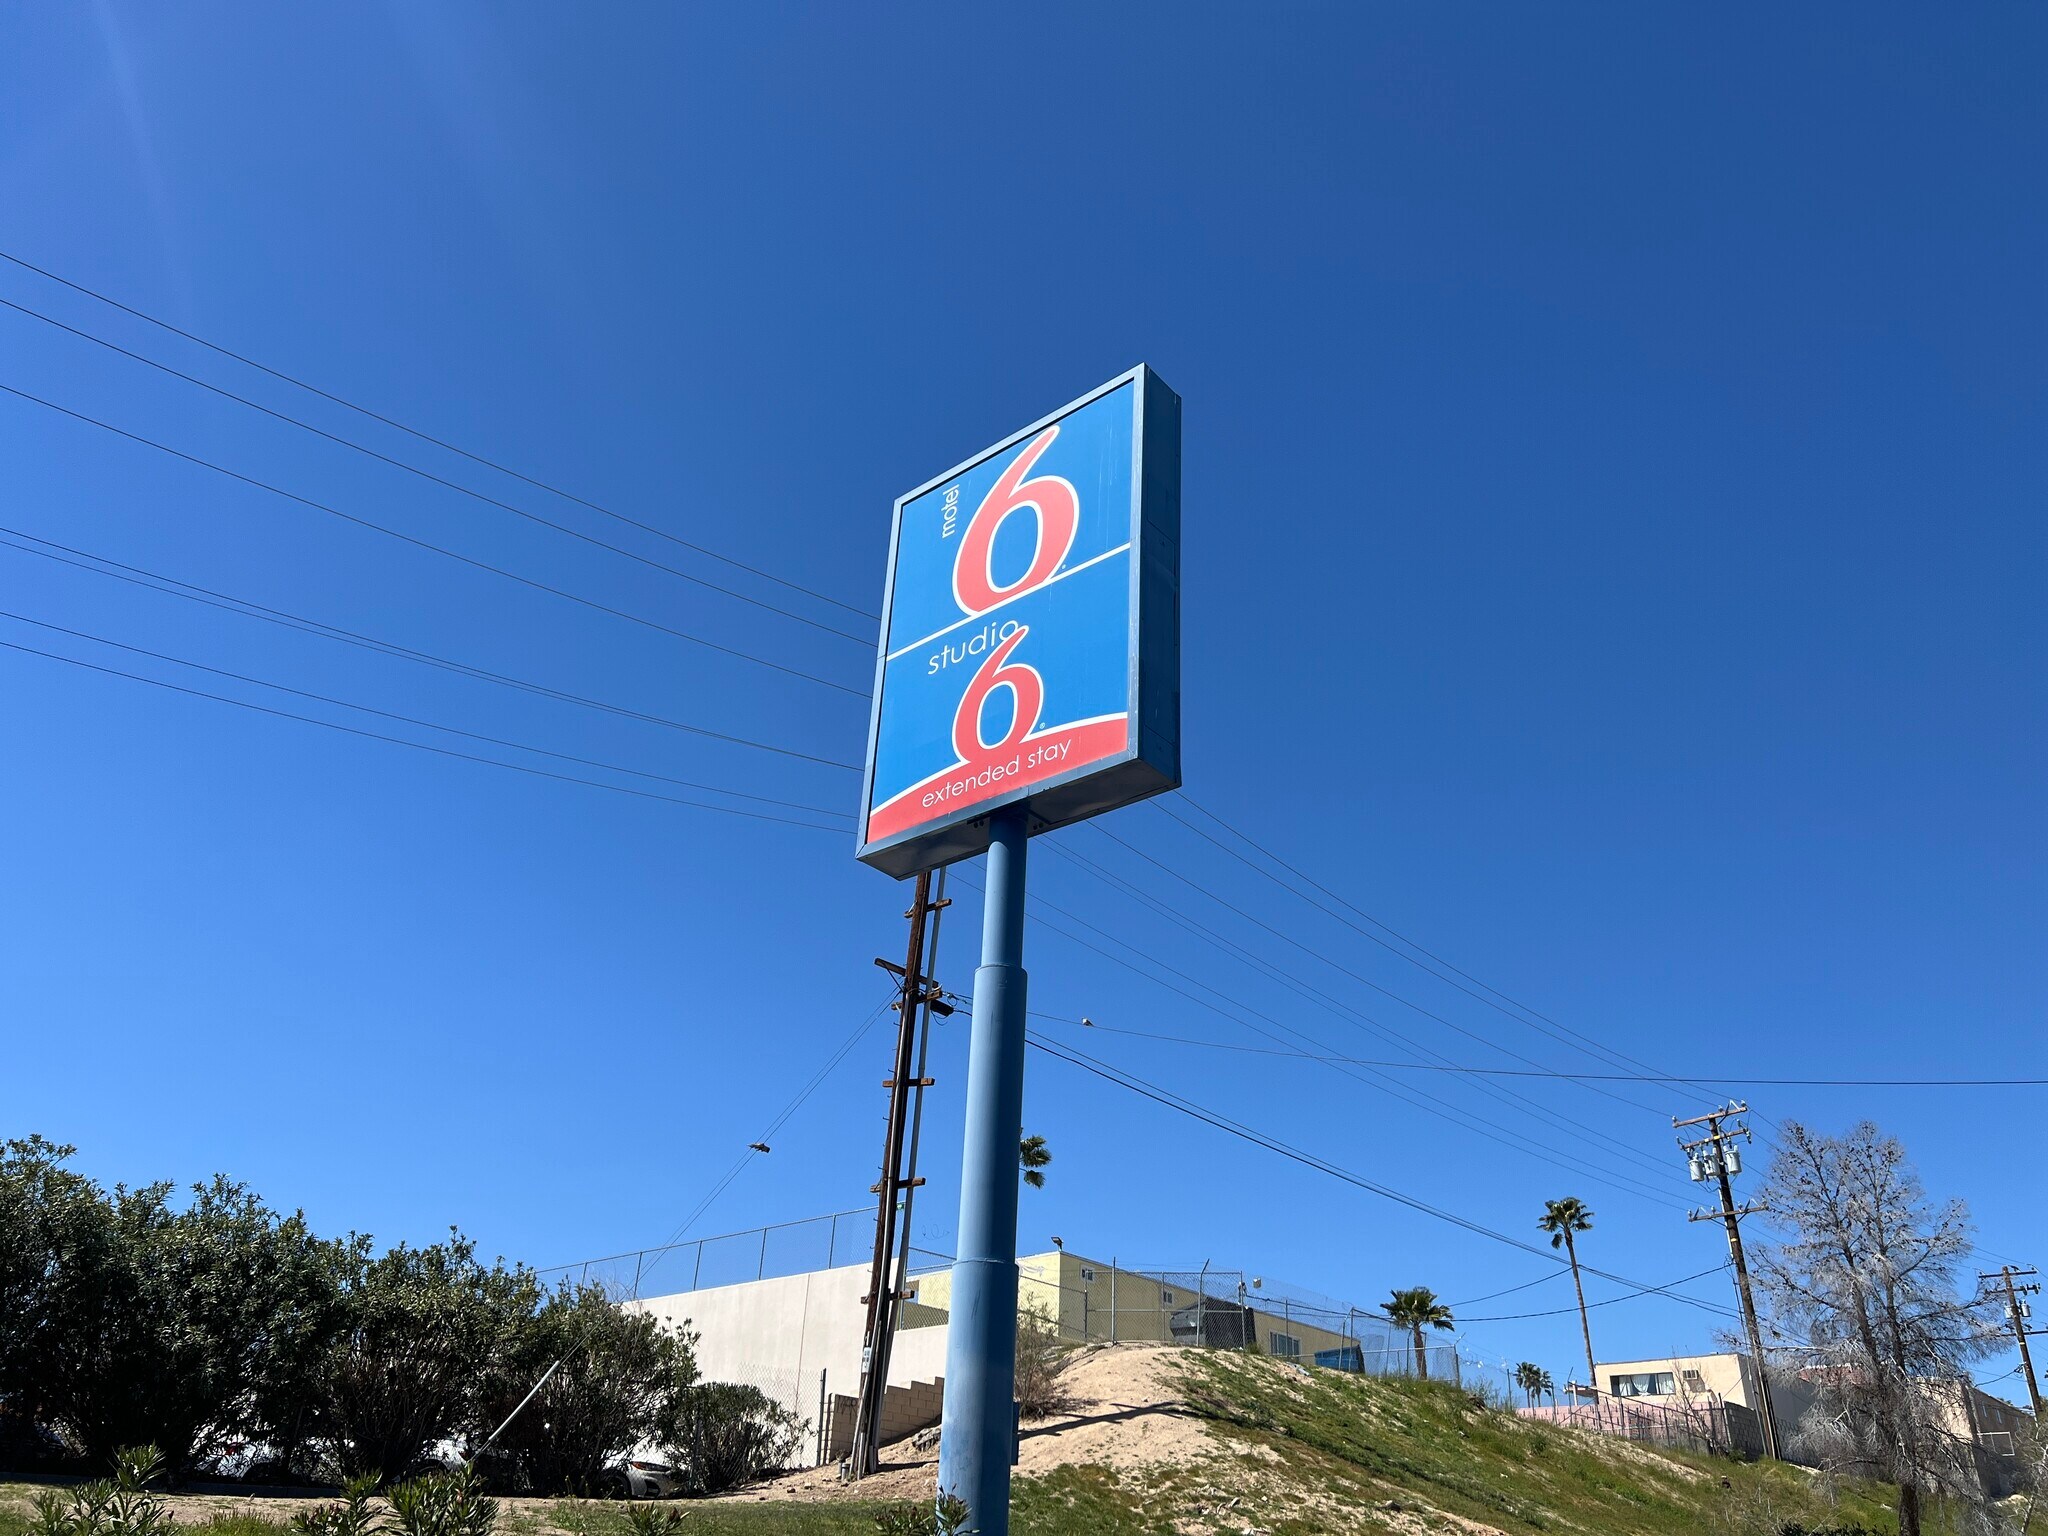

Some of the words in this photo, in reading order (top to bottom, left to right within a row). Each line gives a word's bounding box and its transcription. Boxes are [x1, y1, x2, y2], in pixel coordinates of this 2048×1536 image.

[941, 484, 960, 539] motel
[952, 425, 1080, 618] 6
[927, 620, 1019, 676] studio
[952, 625, 1044, 763] 6
[922, 755, 1020, 808] extended
[1027, 739, 1071, 769] stay
